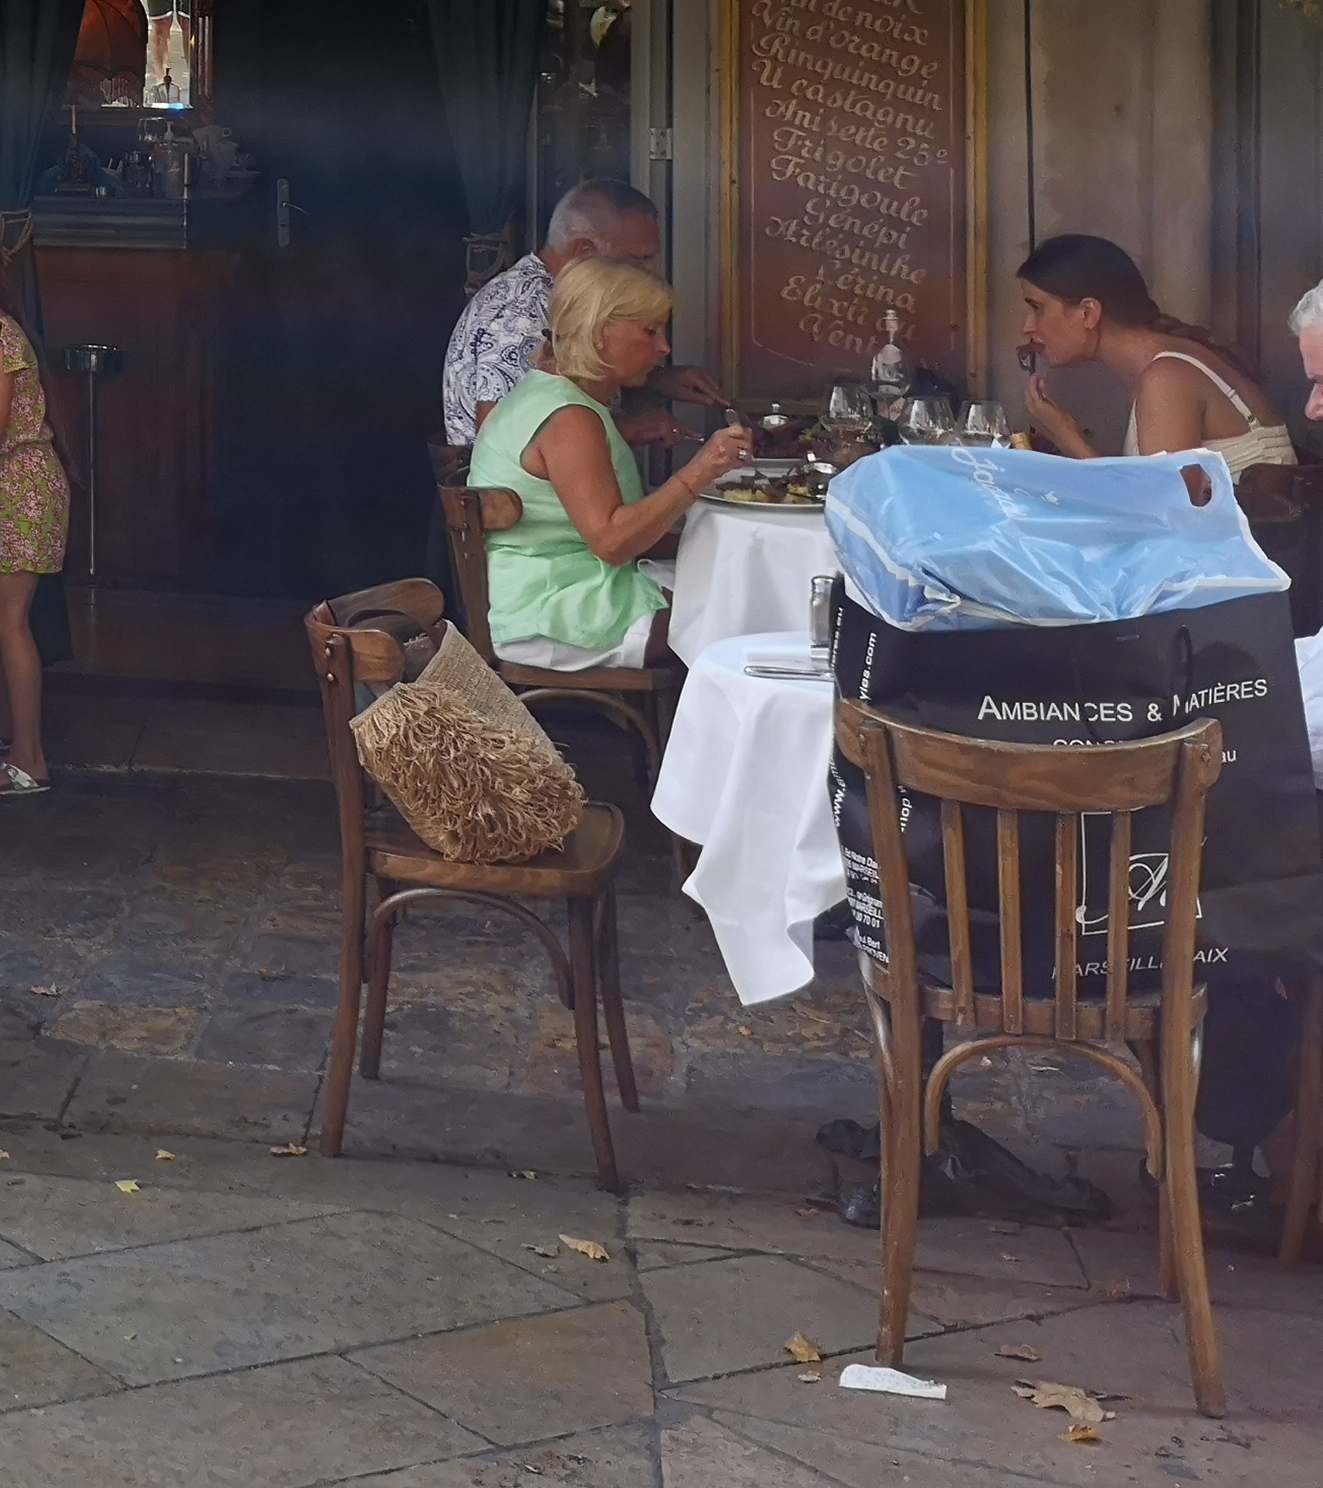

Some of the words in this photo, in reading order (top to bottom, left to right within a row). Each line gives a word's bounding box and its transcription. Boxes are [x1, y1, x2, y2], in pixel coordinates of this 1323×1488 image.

[752, 0, 801, 36] Vin
[855, 11, 929, 46] noix
[752, 32, 943, 112] Rinquinquin
[772, 126, 919, 190] Frigolet
[770, 154, 929, 227] Farigoule
[803, 197, 912, 251] Génépi
[1146, 703, 1163, 722] &
[1193, 947, 1229, 963] AIX
